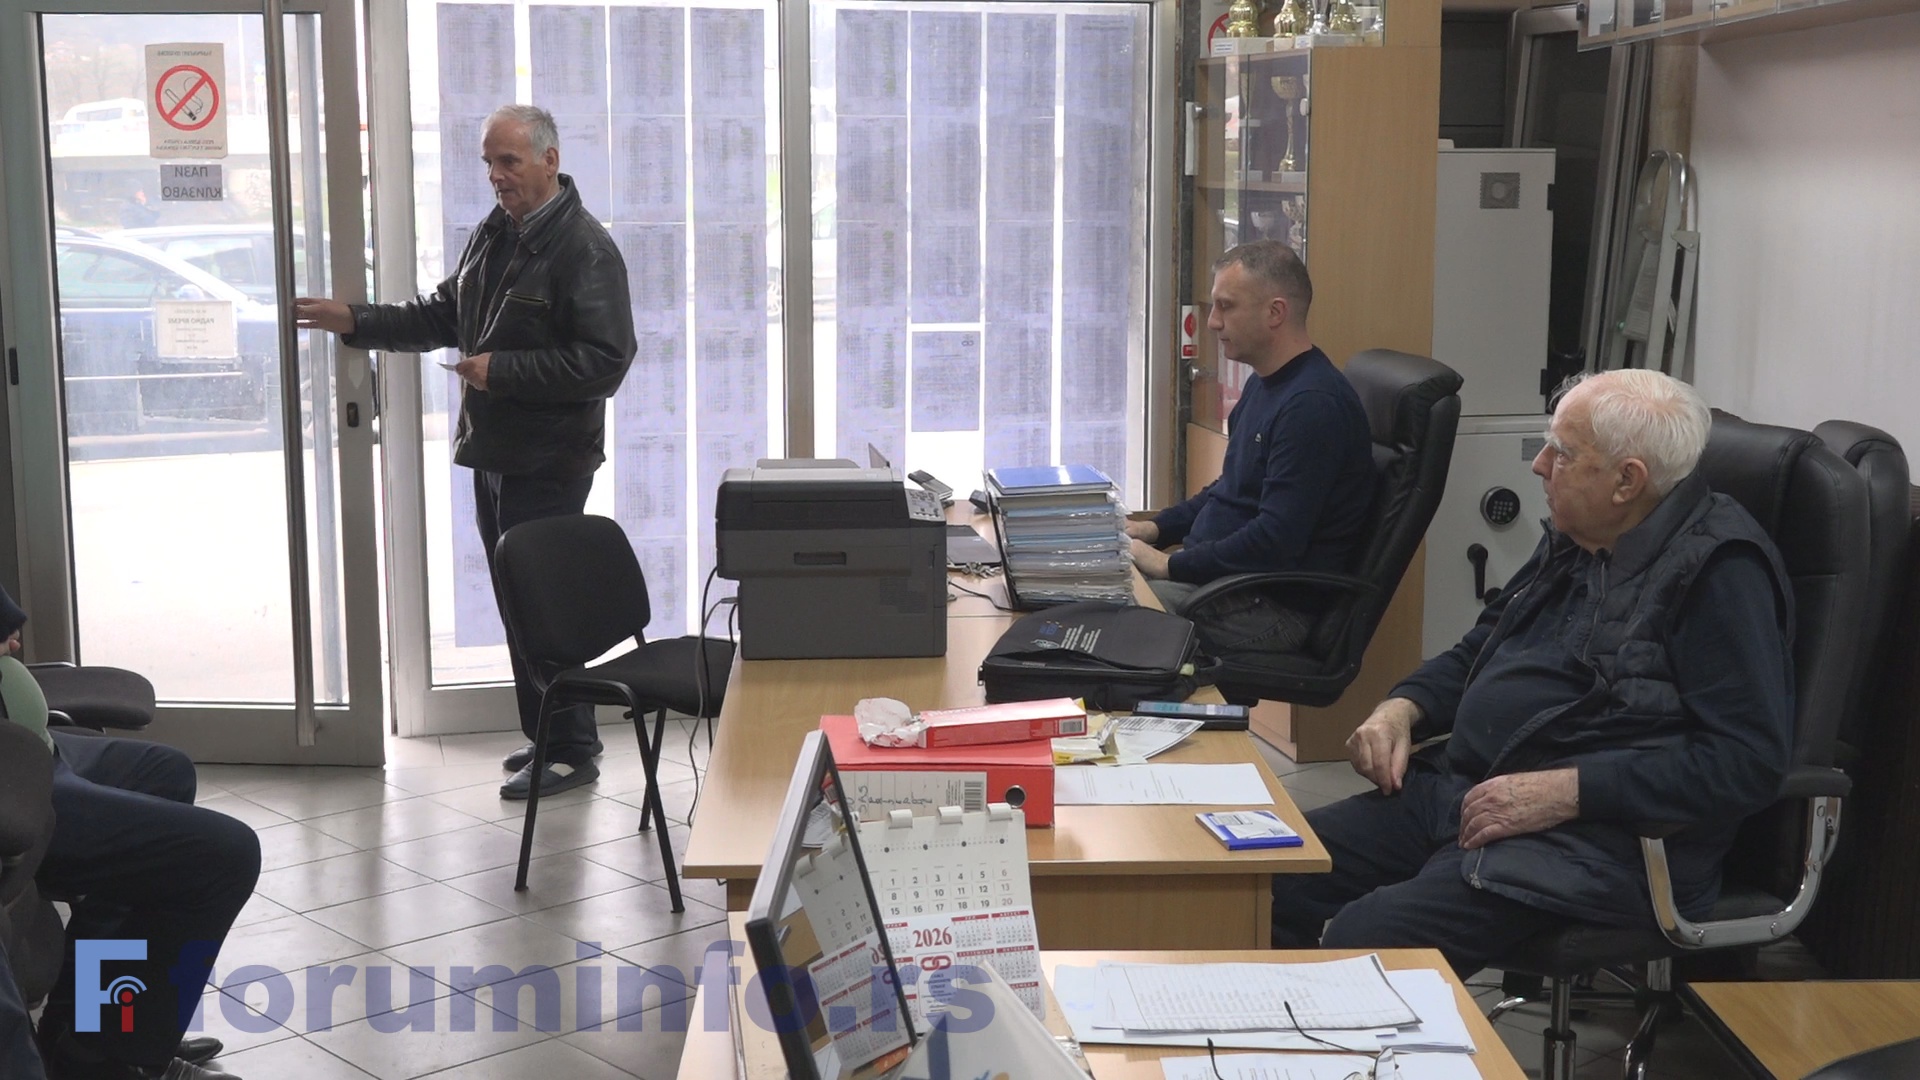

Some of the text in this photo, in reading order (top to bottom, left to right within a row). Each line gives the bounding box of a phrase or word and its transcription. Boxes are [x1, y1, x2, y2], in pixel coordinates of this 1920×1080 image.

[890, 869, 1007, 886] 1 2 3 4 5 6
[891, 884, 1010, 901] 8 9 10 11 12 13
[913, 905, 922, 913] 16
[936, 903, 944, 912] 17
[957, 901, 968, 910] 18
[981, 900, 990, 908] 19
[1002, 897, 1013, 906] 20
[912, 926, 953, 948] 2026
